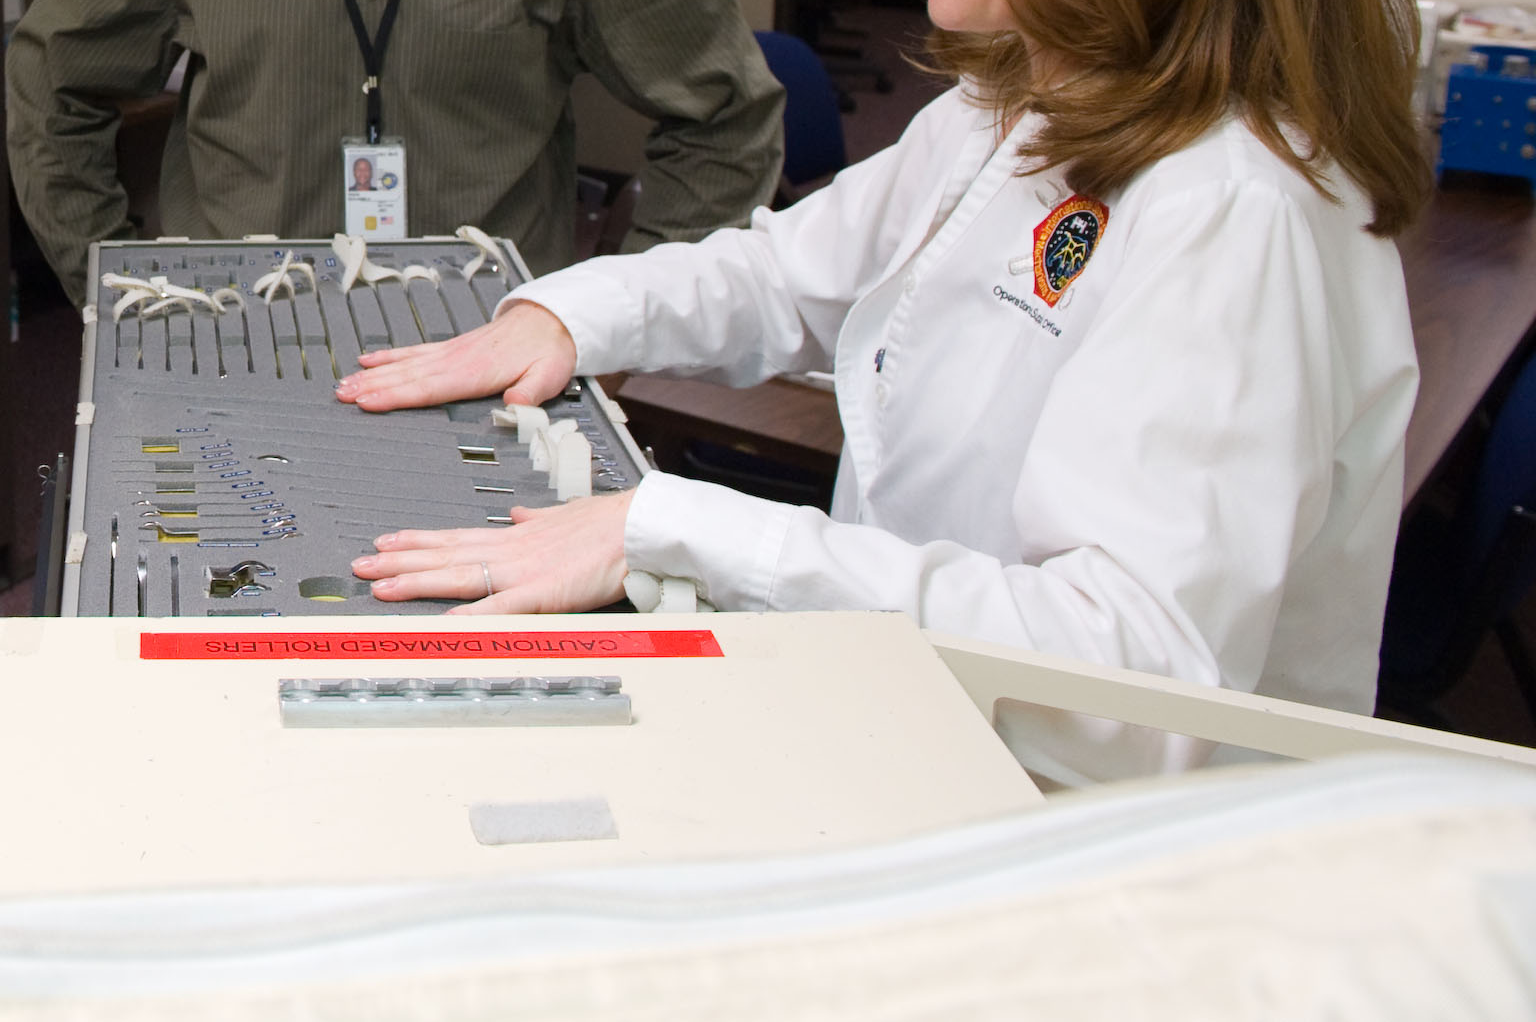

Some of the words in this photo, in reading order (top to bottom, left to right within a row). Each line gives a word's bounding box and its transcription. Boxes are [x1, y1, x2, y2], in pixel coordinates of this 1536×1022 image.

[204, 640, 332, 654] ROLLERS
[340, 639, 483, 654] DAMAGED
[492, 638, 618, 653] CAUTION
